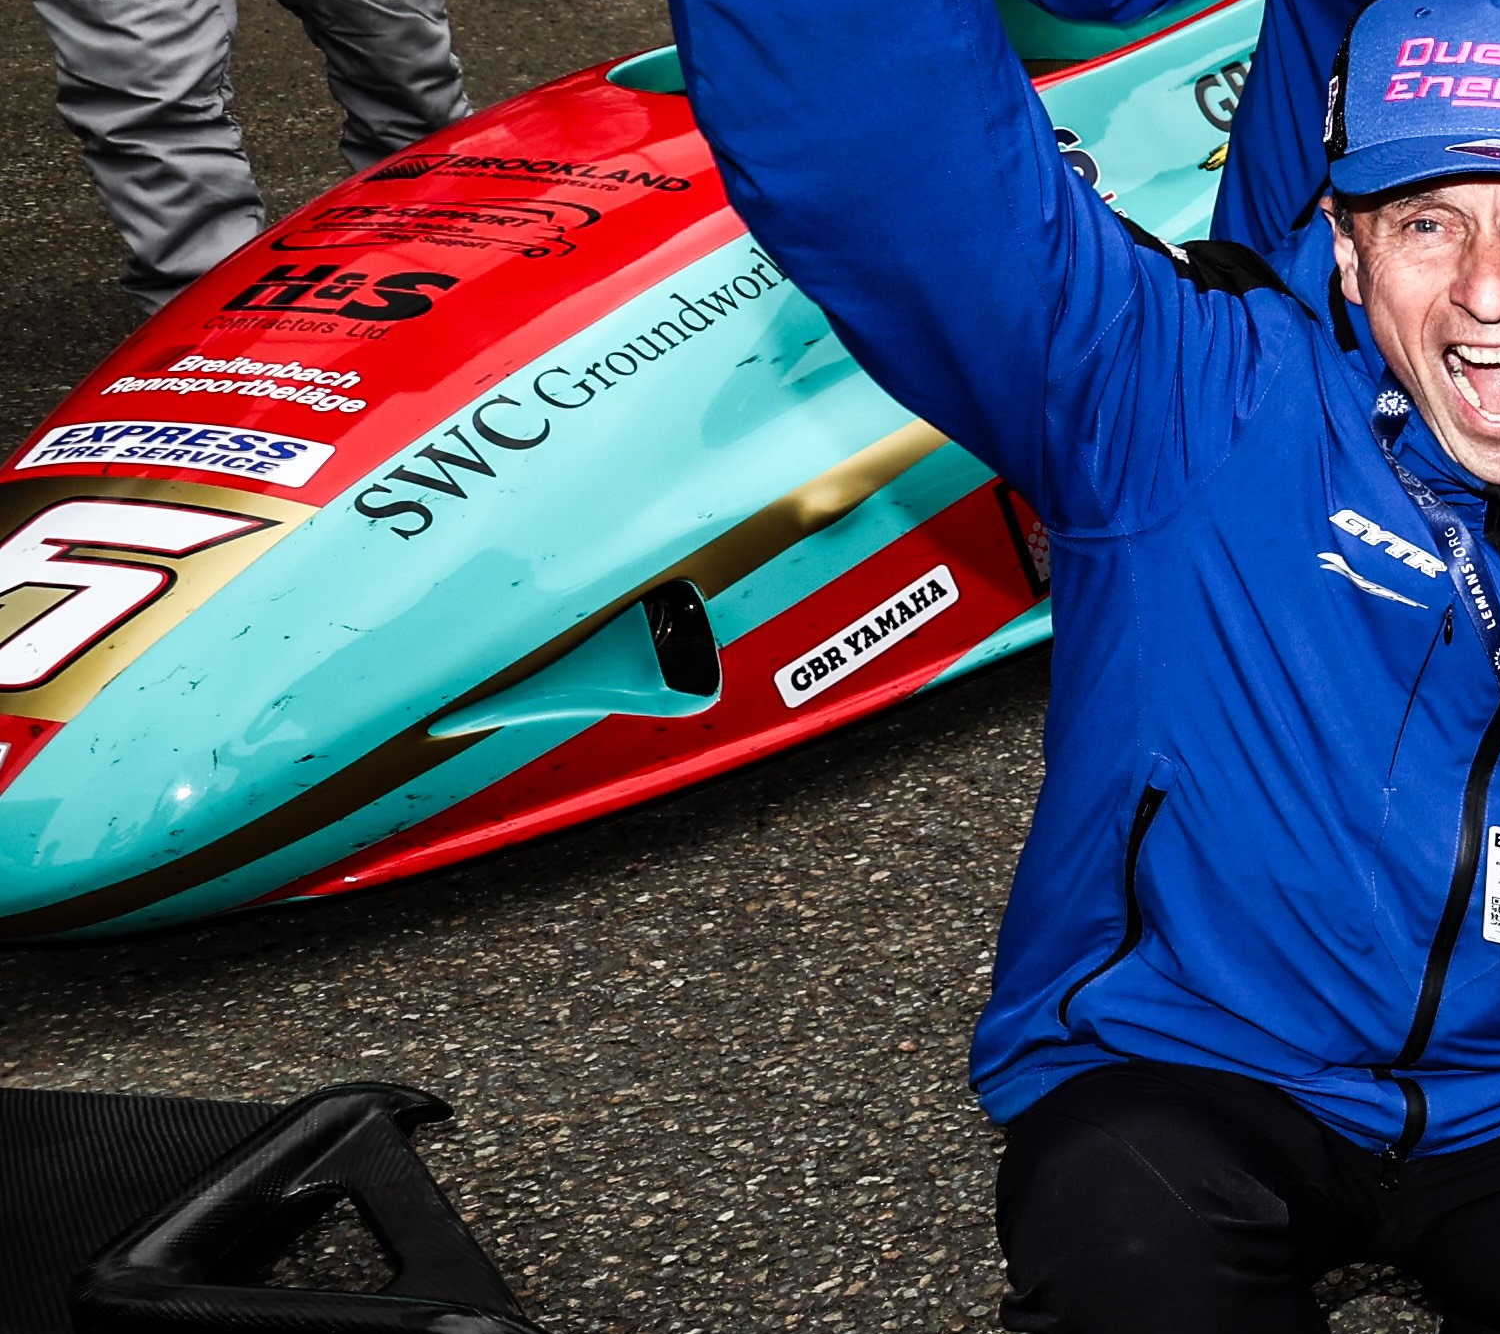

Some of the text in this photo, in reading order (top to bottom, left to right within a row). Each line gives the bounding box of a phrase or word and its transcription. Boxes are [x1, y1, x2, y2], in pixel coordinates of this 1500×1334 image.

[450, 156, 692, 193] BROOKLAND
[221, 264, 461, 321] H&S
[203, 315, 390, 342] Contractors Ltd.
[168, 355, 362, 389] Breitenbach
[100, 376, 368, 413] Rennsportbeläge
[34, 445, 281, 475] TYRE SERVICE
[54, 425, 307, 461] EXPRESS
[354, 394, 551, 540] SWC
[1329, 509, 1447, 578] GYTR
[1444, 527, 1496, 630] LEMANS.ORG
[790, 579, 947, 691] GBR YAMAHA
